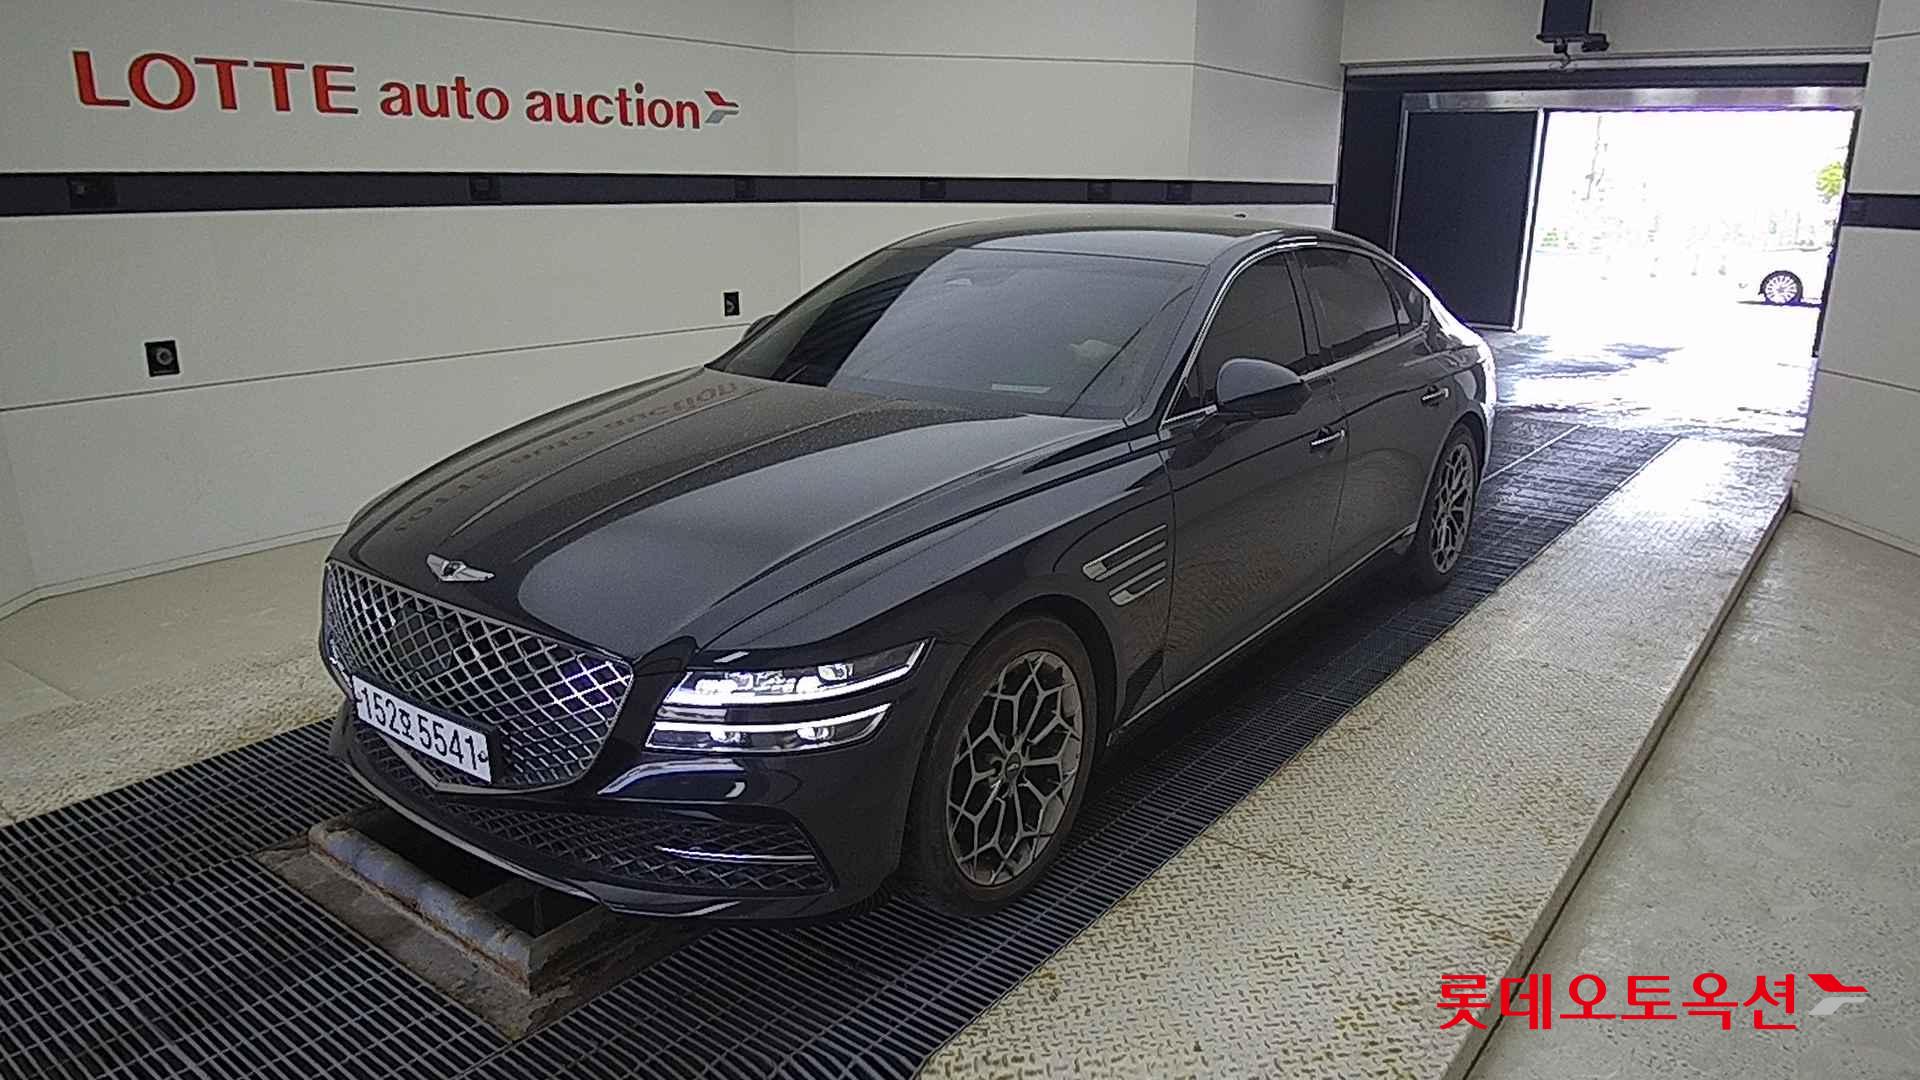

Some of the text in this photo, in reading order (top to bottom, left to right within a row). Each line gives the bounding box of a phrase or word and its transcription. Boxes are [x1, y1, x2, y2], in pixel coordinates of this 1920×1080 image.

[72, 50, 702, 129] LOTTE auto auction
[417, 714, 478, 770] 5541
